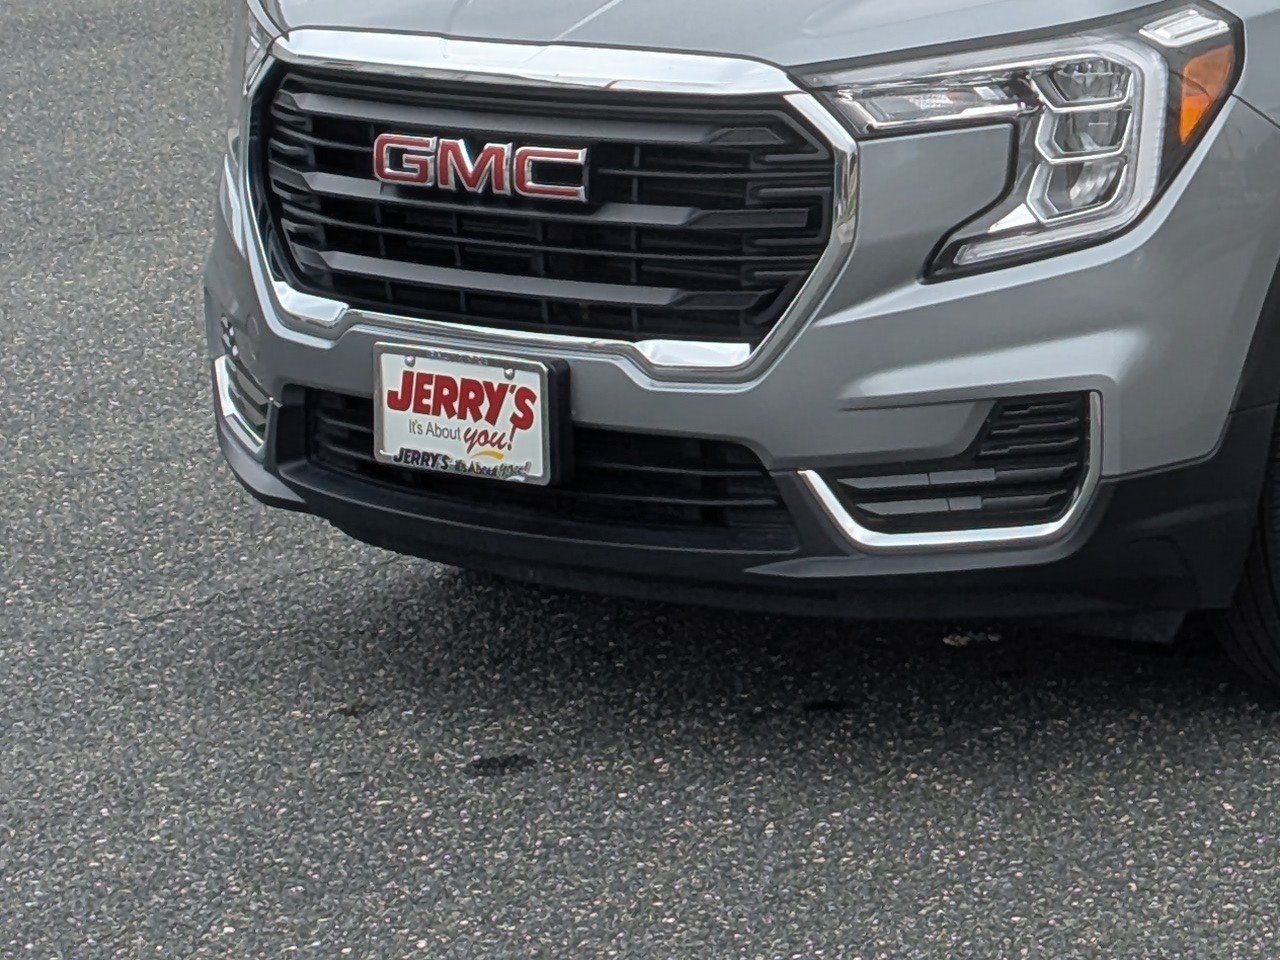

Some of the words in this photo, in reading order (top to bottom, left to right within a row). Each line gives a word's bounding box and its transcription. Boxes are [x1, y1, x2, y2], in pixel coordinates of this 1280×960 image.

[373, 133, 588, 203] GMC
[386, 370, 538, 430] JERRY'S
[393, 447, 450, 471] JERRY'S
[408, 419, 423, 435] It's
[425, 421, 461, 441] About
[463, 423, 518, 454] you!
